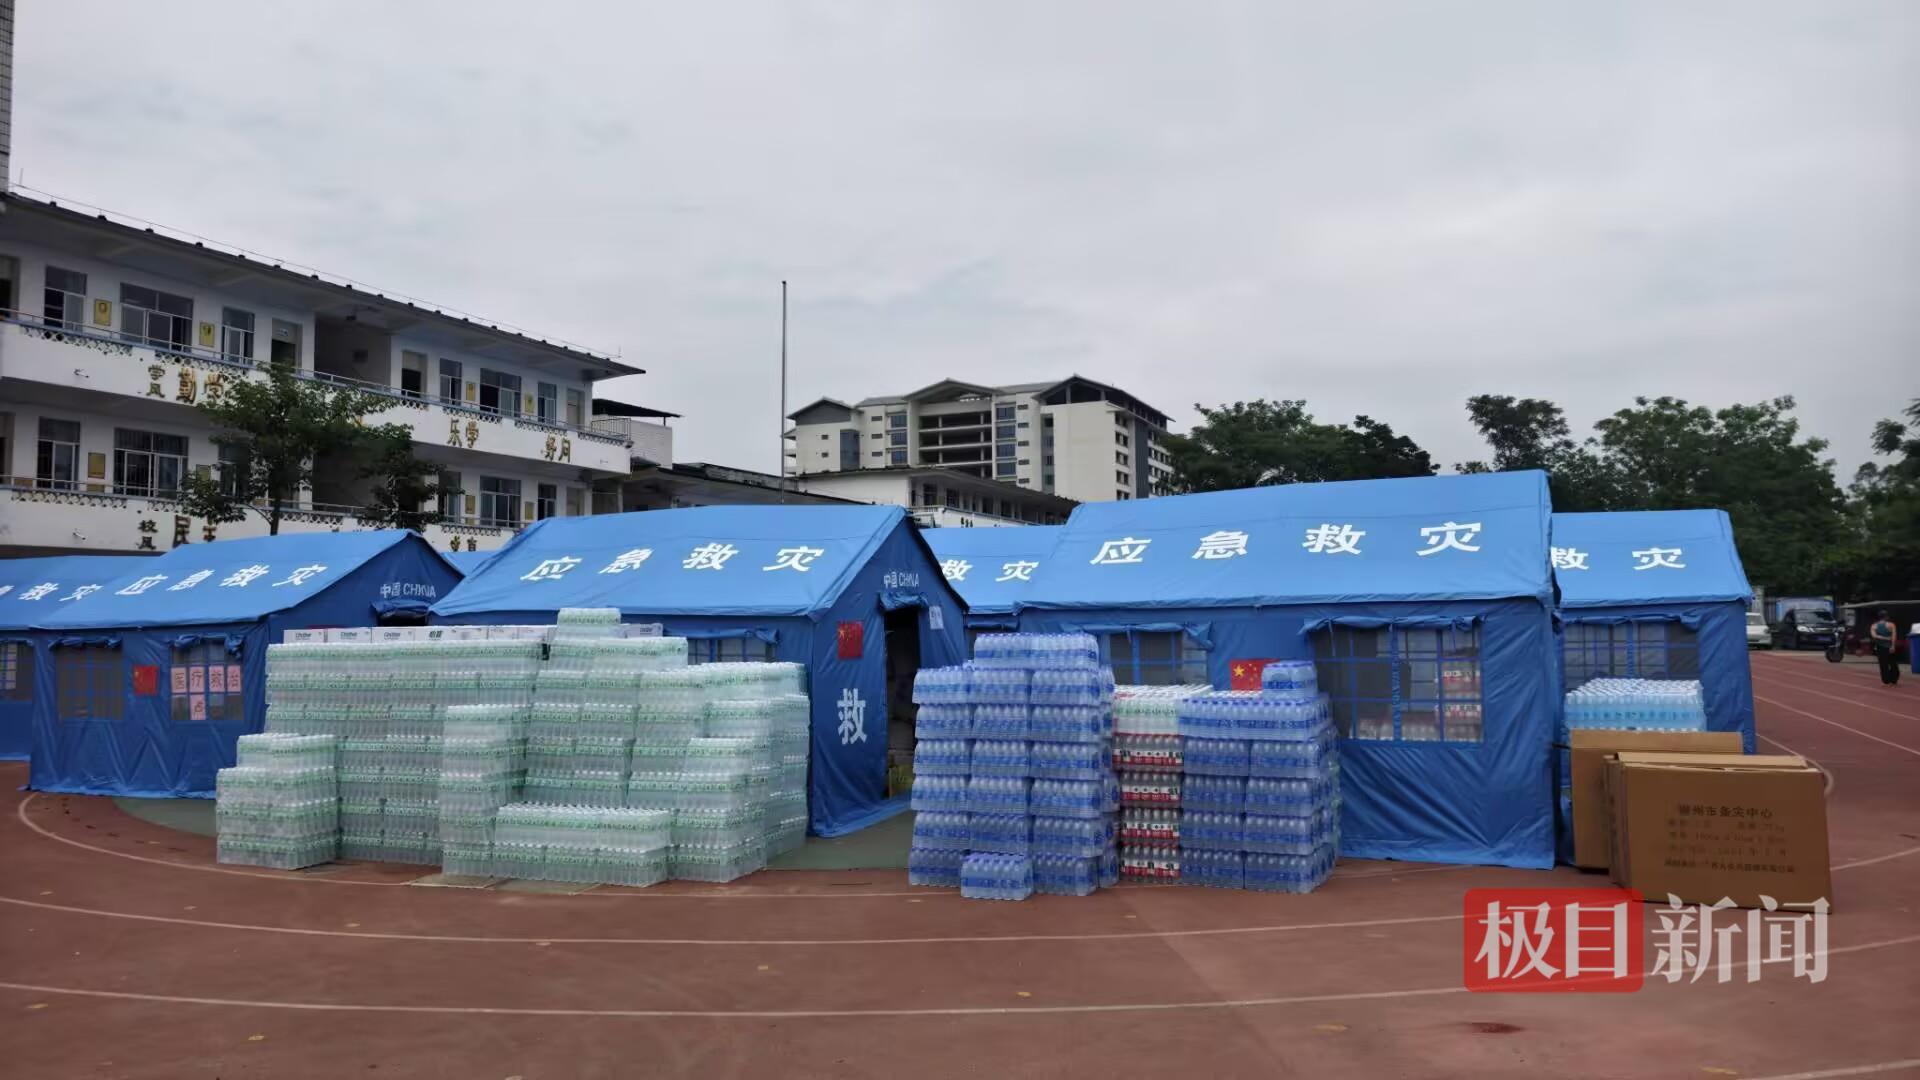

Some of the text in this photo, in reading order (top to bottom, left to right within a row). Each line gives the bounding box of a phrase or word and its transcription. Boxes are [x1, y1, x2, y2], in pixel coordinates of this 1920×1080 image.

[1089, 521, 1482, 565] 应急救灾
[1551, 545, 1687, 570] 救灾
[520, 542, 824, 581] 应急救灾
[940, 559, 1039, 582] 救灾
[114, 564, 328, 595] 应急救灾
[837, 688, 867, 745] 救
